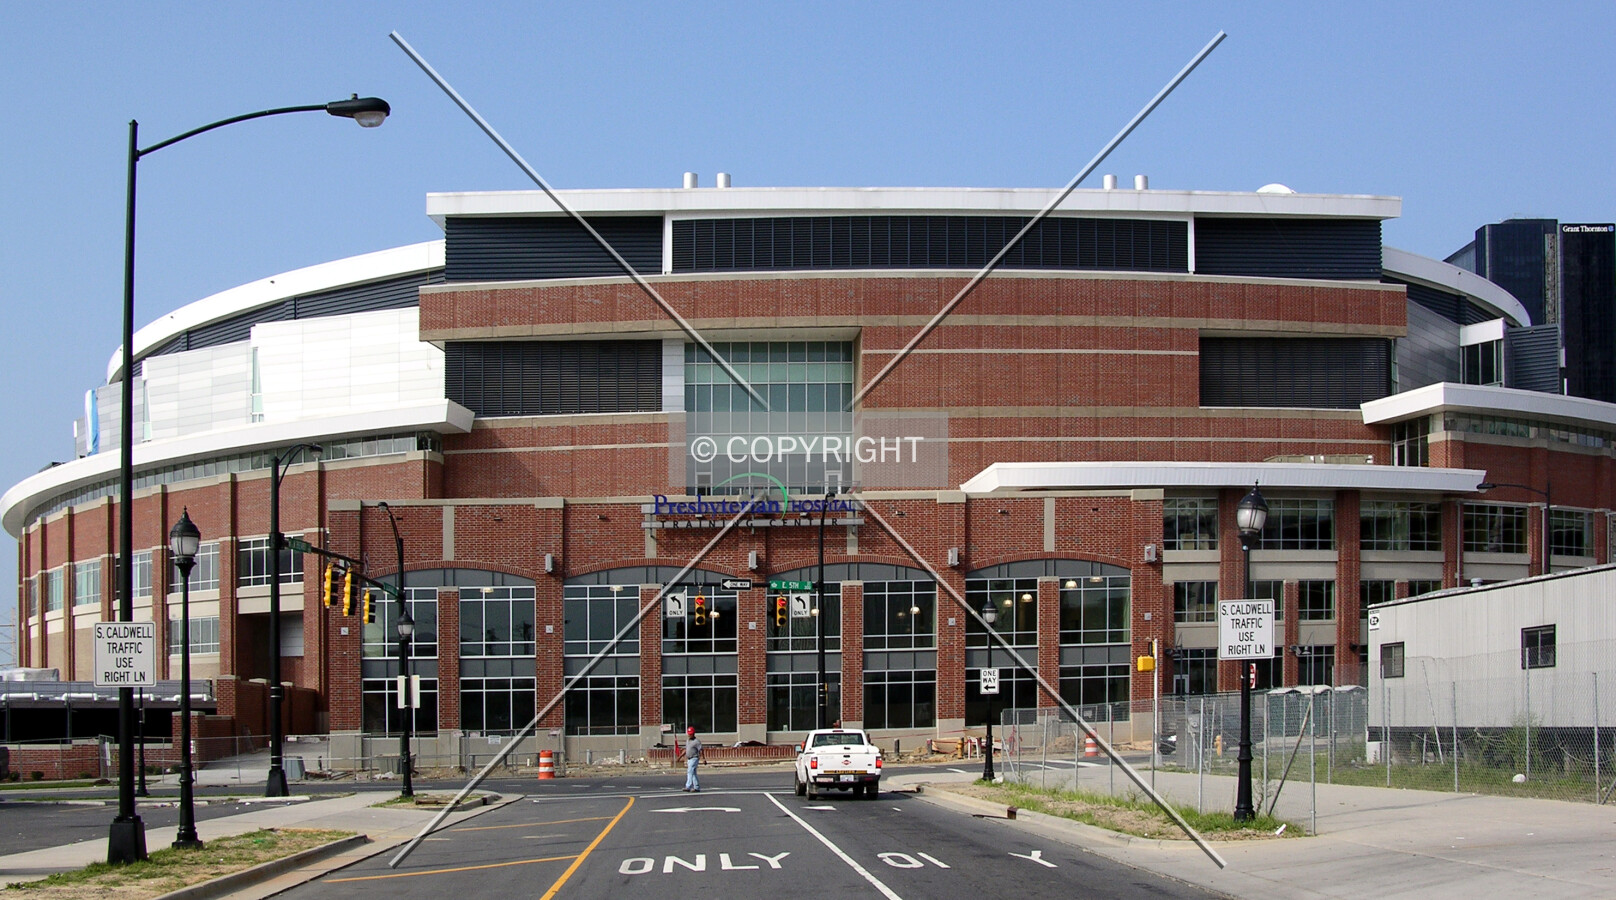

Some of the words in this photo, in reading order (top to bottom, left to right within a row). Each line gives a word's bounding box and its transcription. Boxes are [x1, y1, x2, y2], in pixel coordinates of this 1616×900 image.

[1562, 225, 1580, 233] Grant
[1580, 225, 1608, 233] Thornton
[652, 494, 780, 519] Presbyterian
[769, 518, 839, 527] CENTR
[789, 581, 799, 589] 5TH
[1221, 604, 1229, 616] S.
[1230, 603, 1272, 616] CALDWELL
[1231, 618, 1263, 629] TRAFFIC
[96, 626, 105, 639] S.
[106, 626, 152, 638] CALDWELL
[1238, 631, 1255, 642] USE
[107, 642, 143, 654] TRAFFIC
[1228, 645, 1251, 655] RIGHT
[1254, 644, 1265, 654] LN
[115, 657, 134, 668] USE
[104, 671, 130, 682] RIGHT
[134, 671, 146, 682] LN
[618, 851, 791, 874] ONLY
